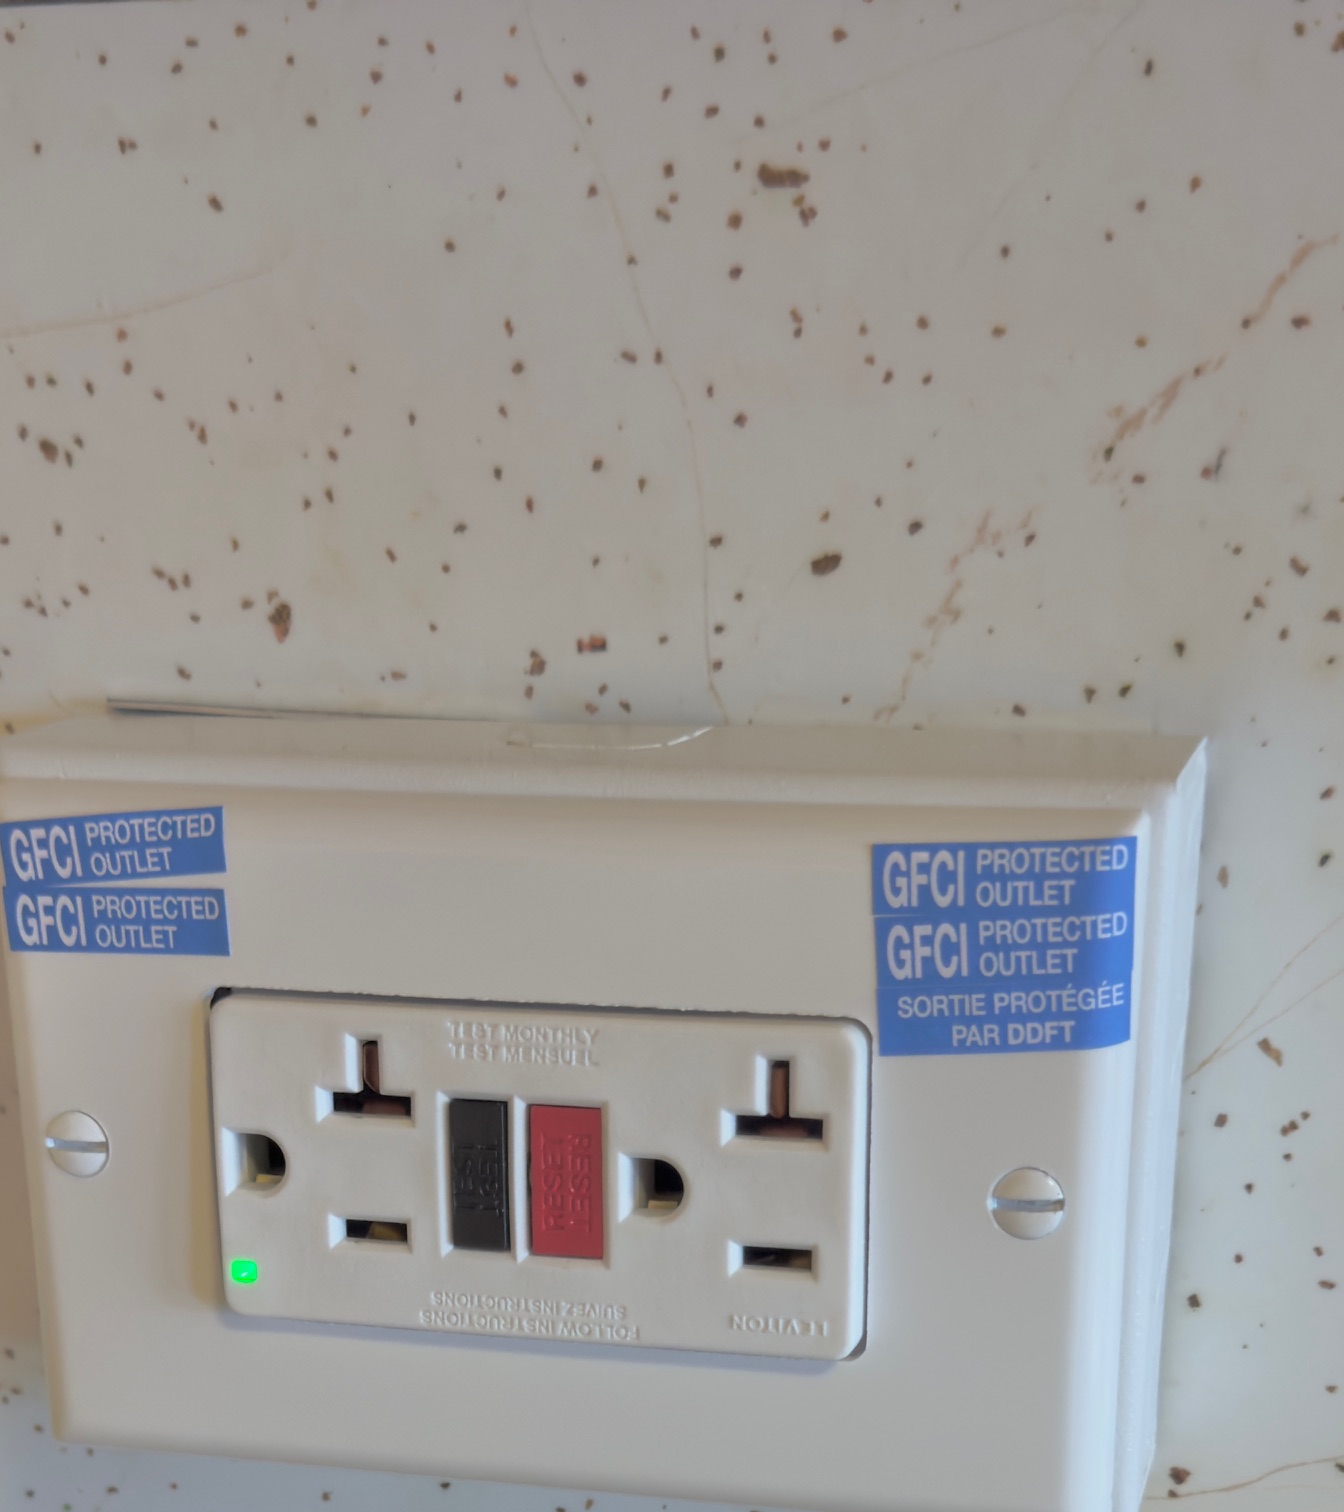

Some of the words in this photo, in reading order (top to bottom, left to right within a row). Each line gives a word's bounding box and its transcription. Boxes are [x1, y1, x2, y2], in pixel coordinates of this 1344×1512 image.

[84, 813, 216, 847] PROTECTED
[9, 824, 83, 882] GFCI
[90, 847, 172, 877] OUTLET
[976, 844, 1129, 875] PROTECTED
[882, 850, 965, 909] GFCI
[91, 895, 220, 920] PROTECTED
[975, 880, 1076, 908] OUTLET
[15, 894, 88, 947] GFCI
[978, 911, 1128, 945] PROTECTED
[95, 925, 177, 949] OUTLET
[886, 923, 969, 981] GFCI
[979, 949, 1078, 977] OUTLET
[897, 993, 986, 1019] SORTIE
[994, 980, 1125, 1015] PROTÉGÉE
[447, 1020, 498, 1041] TEST
[502, 1023, 600, 1046] MONTHLY
[952, 1024, 1000, 1047] PAR
[1007, 1020, 1076, 1046] DDFT
[449, 1042, 498, 1062] TEST
[502, 1045, 600, 1067] MENSUEL
[540, 1132, 564, 1231] RESET
[568, 1133, 592, 1233] RESET
[430, 1291, 562, 1315] INSTRUCTIONS
[566, 1300, 627, 1320] SUIVEZ
[419, 1309, 555, 1335] INSTRUCTIONS
[557, 1320, 640, 1340] FOLLOW
[731, 1313, 830, 1336] LEVITON
